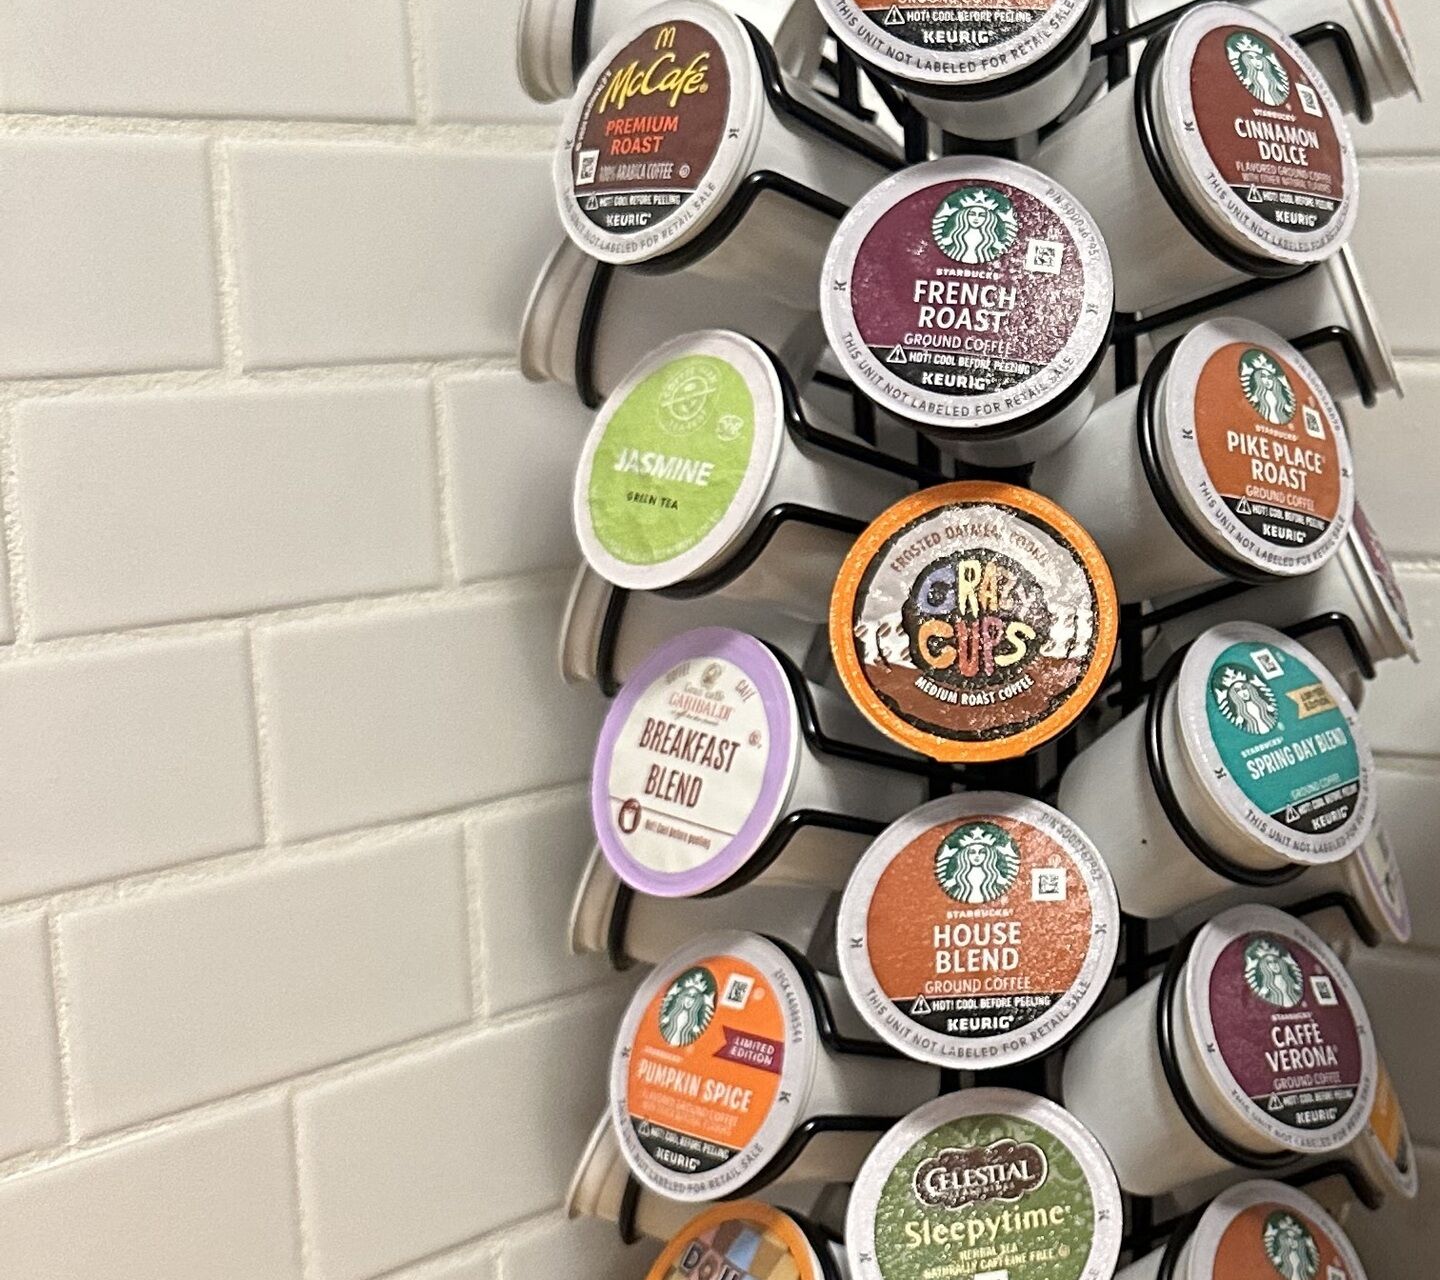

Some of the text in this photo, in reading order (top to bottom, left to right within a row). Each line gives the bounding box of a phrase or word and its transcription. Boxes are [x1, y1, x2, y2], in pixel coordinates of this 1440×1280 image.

[836, 0, 1076, 73] THIS UNIT NOT LABELED FOR RETAIL SALE
[924, 30, 989, 43] KEURIG
[599, 52, 709, 114] McCafé
[605, 116, 678, 136] PREMIUM
[1234, 118, 1319, 149] CINNAMON
[611, 136, 664, 156] ROAST
[1258, 142, 1308, 166] DOLCE
[648, 163, 672, 179] COFFEE
[606, 213, 648, 226] KEURIG
[662, 211, 693, 239] RETAIL
[695, 182, 716, 209] SALE
[1275, 210, 1314, 226] KEURIG
[936, 268, 999, 279] STARBUCKS
[914, 280, 1017, 310] FRENCH
[918, 306, 1006, 333] ROAST
[904, 333, 1012, 356] GROUND COFFEE
[909, 352, 933, 364] HOT!
[934, 354, 957, 366] COOL
[843, 332, 861, 361] THIS
[858, 359, 884, 384] UNIT
[883, 380, 908, 405] NOT
[911, 400, 970, 417] LABELED
[975, 402, 1001, 415] FOR
[1005, 381, 1049, 408] RETAIL
[922, 372, 985, 390] KEURIG
[1226, 430, 1323, 475] PIKE PLACE
[614, 448, 716, 487] JASMINE
[1250, 459, 1308, 492] ROAST
[626, 491, 679, 510] GREEN TEA
[1246, 484, 1287, 504] GROUND
[1199, 480, 1216, 508] THIS
[1215, 508, 1236, 538] UNIT
[1256, 548, 1294, 567] LABELED
[1262, 523, 1303, 542] KEURIG
[890, 530, 942, 572] FROSTED
[918, 616, 1036, 678] CUPS
[914, 674, 1035, 706] MEDIUM ROAST COFFEE
[640, 717, 741, 773] BREAKFAST
[1246, 727, 1348, 780] SPRING DAY BLEND
[645, 764, 703, 808] BLEND
[1246, 808, 1292, 846] THIS UNIT
[947, 911, 1009, 919] STARBUCKS
[933, 922, 1022, 948] HOUSE
[935, 948, 1019, 973] BLEND
[925, 977, 1032, 994] GROUND COFFEE
[932, 996, 1051, 1011] HOT! COOL BEFORE PEELING
[866, 980, 1092, 1059] THIS UNIT NOT LABELED FOR RETAIL SALE
[947, 1017, 1010, 1031] KEURIG
[730, 1047, 773, 1065] EDITION
[734, 1036, 775, 1054] LIMITED
[1265, 1044, 1338, 1072] VERONA
[637, 1059, 701, 1097] PUMPKIN
[703, 1078, 753, 1112] SPICE
[1273, 1073, 1314, 1091] GROUND
[655, 1146, 699, 1171] KEURIG
[741, 1143, 763, 1170] SALE
[925, 1159, 1037, 1196] CELESTIAL
[904, 1204, 1064, 1249] Sleepytime
[1029, 1248, 1054, 1262] FREE
